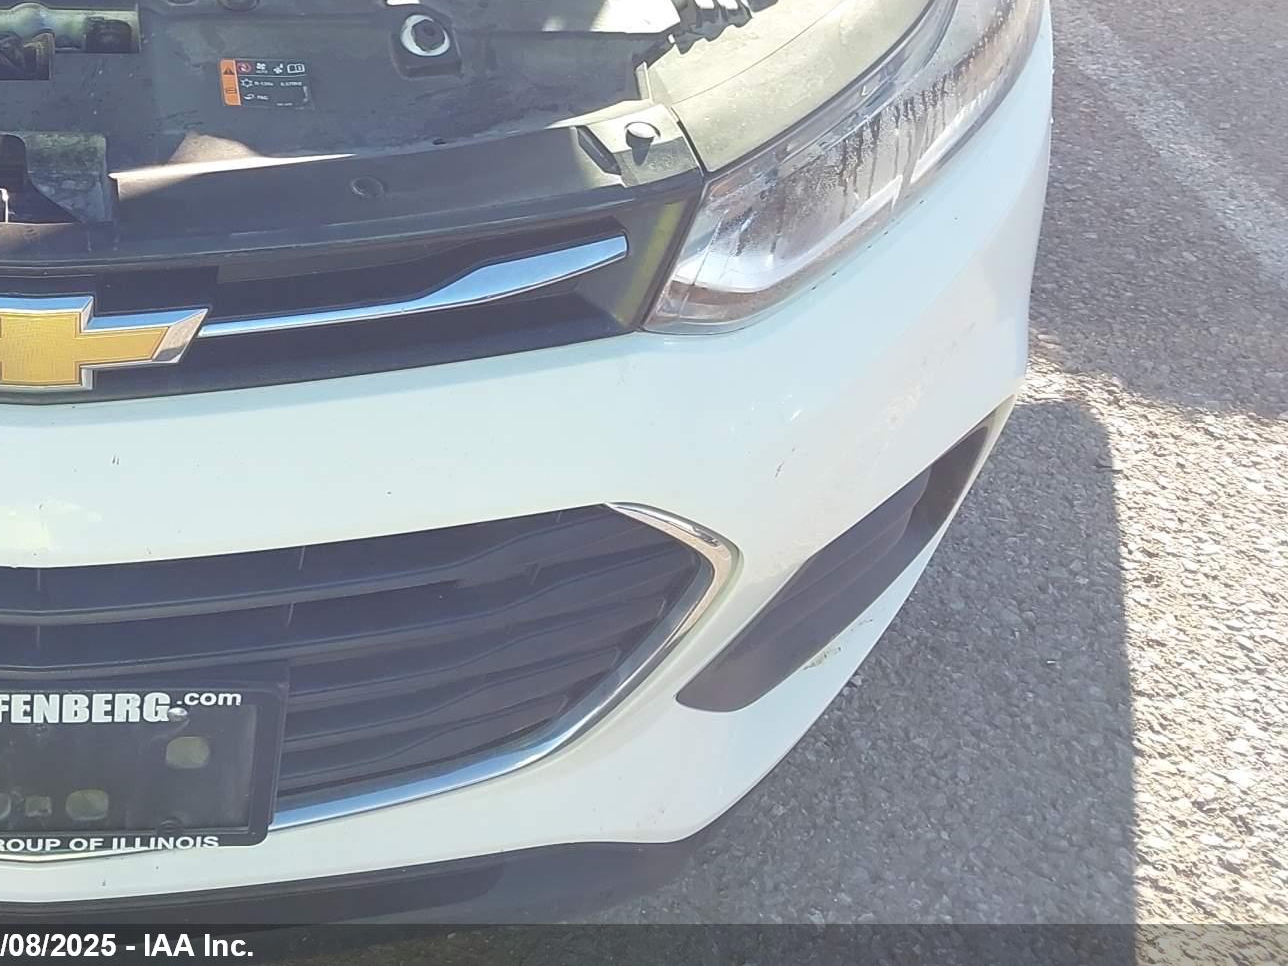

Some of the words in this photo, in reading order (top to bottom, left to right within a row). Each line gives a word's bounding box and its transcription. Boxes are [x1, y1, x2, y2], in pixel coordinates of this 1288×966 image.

[176, 692, 242, 706] .com
[69, 837, 105, 851] OF
[112, 835, 220, 851] ILLINOIS
